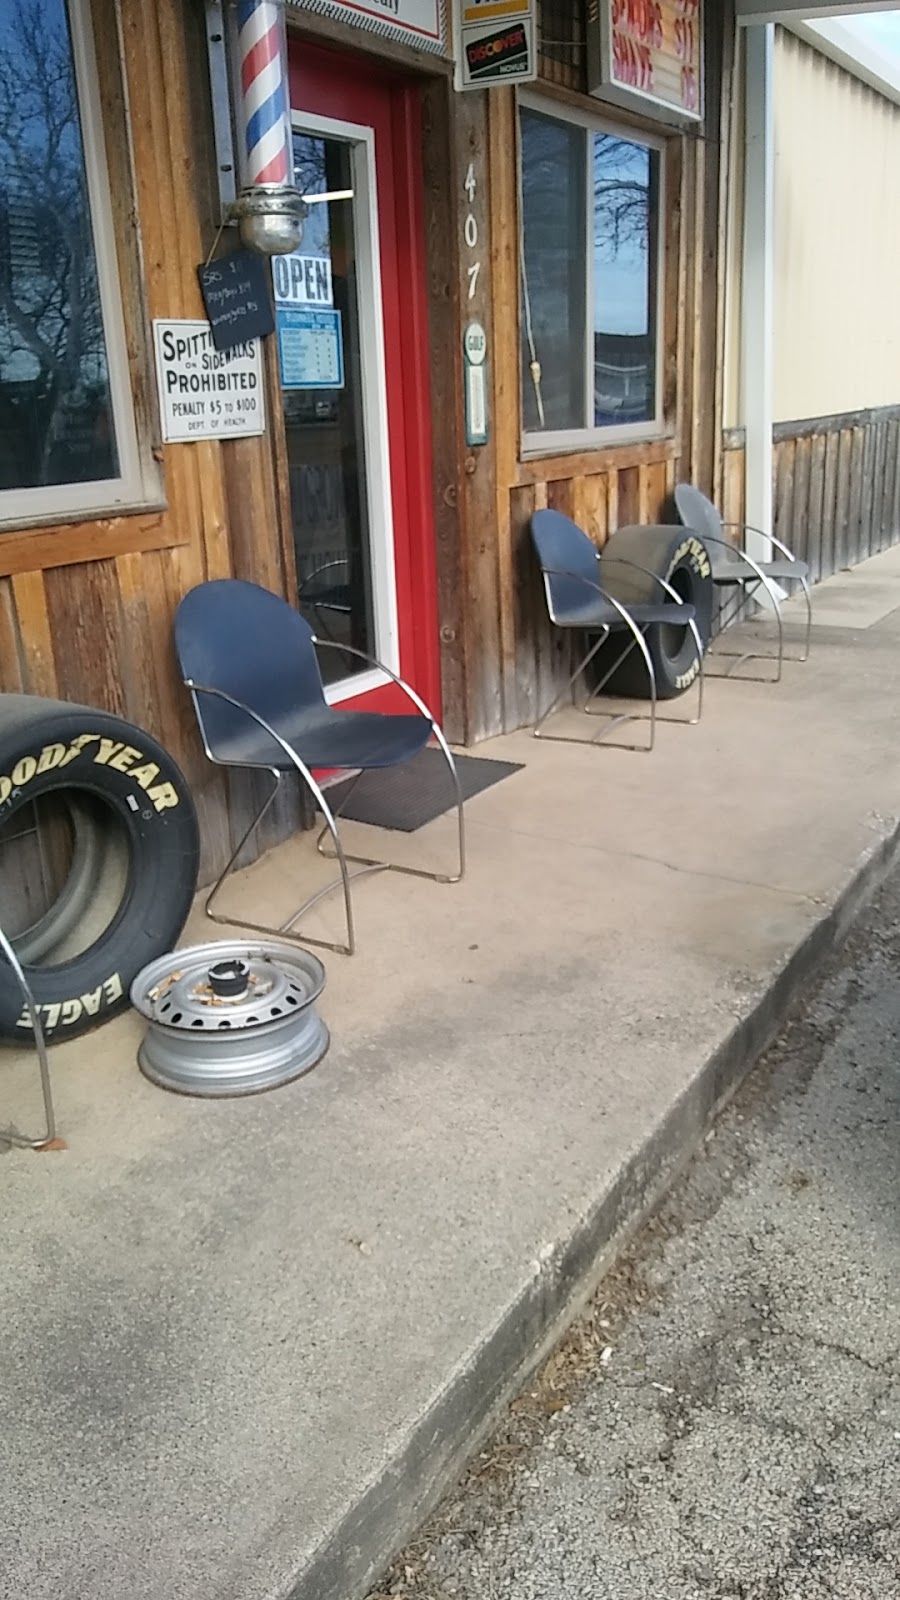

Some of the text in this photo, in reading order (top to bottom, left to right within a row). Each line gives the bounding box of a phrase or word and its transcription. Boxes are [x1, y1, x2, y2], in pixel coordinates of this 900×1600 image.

[468, 31, 523, 63] DISCOVER
[500, 62, 526, 73] NOVUS
[464, 163, 480, 300] 407
[274, 255, 329, 301] OPEN
[162, 330, 212, 362] SPITTI
[202, 340, 255, 370] SIDEWALKS
[468, 335, 484, 351] GULF
[166, 370, 257, 394] PROHIBITED
[172, 401, 205, 417] PENALTY
[209, 400, 222, 415] $5
[236, 398, 256, 411] $100
[210, 420, 219, 428] OF
[224, 418, 246, 426] HEALTH
[0, 734, 179, 813] OODYEAR
[16, 972, 123, 1028] EAGLE
